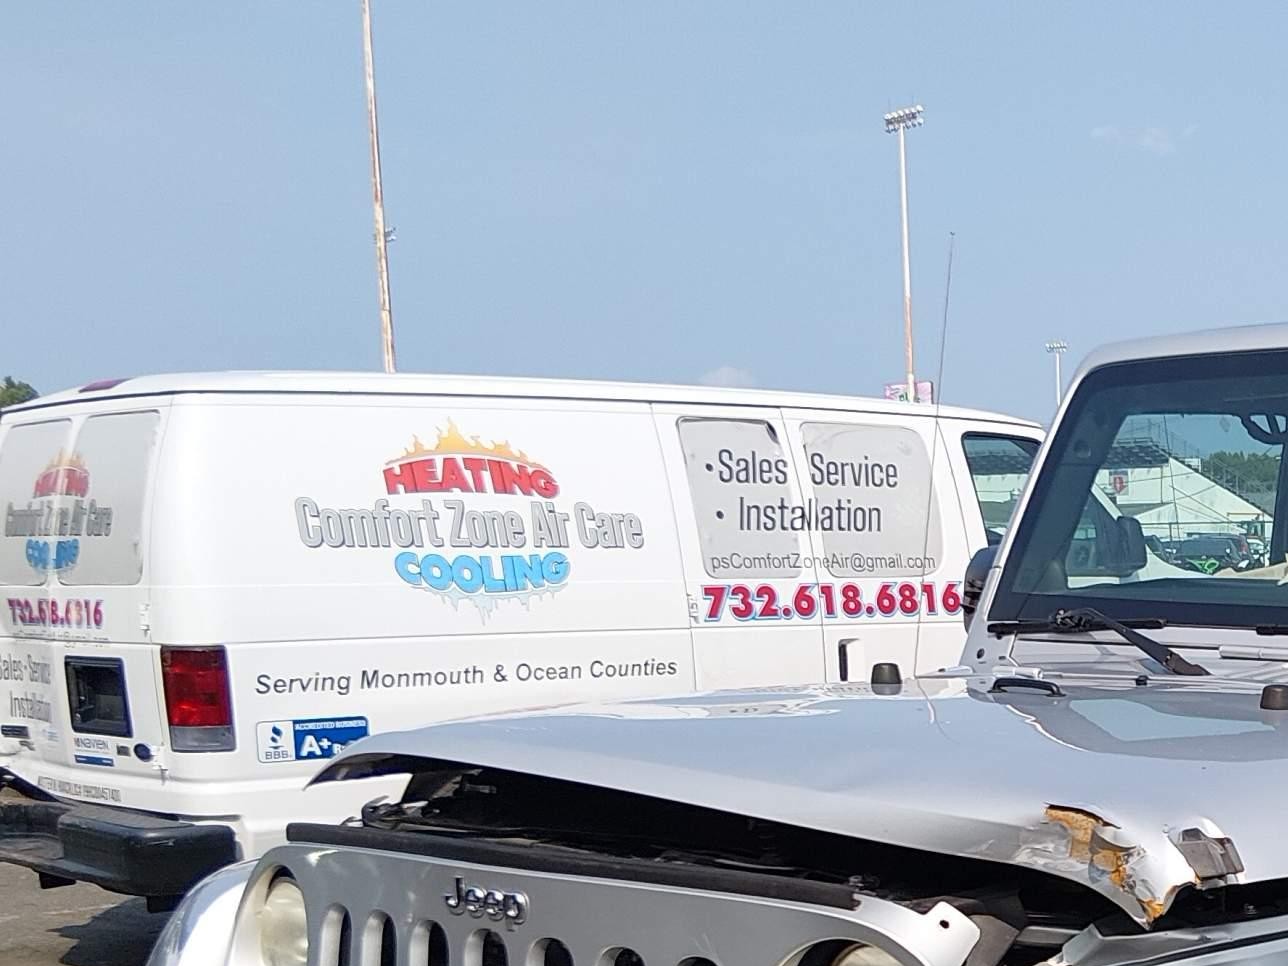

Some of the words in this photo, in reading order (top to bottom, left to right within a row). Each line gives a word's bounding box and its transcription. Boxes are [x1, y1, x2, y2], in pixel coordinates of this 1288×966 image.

[383, 457, 560, 499] HEATING
[718, 449, 788, 484] Sales
[810, 453, 898, 488] Service
[295, 497, 444, 548] Comfort
[445, 498, 526, 548] Zone
[530, 500, 570, 548] Air
[574, 500, 645, 548] Care
[739, 497, 882, 532] Installation
[394, 552, 570, 594] COOLING
[712, 553, 936, 572] psComfortZoneAir@gmail.com
[701, 581, 962, 622] 732.618.6816
[256, 673, 351, 695] Serving
[360, 665, 485, 690] Monmouth
[493, 665, 508, 683] &
[516, 663, 583, 681] Ocean
[590, 658, 678, 679] Counties
[444, 875, 529, 932] Jeep
